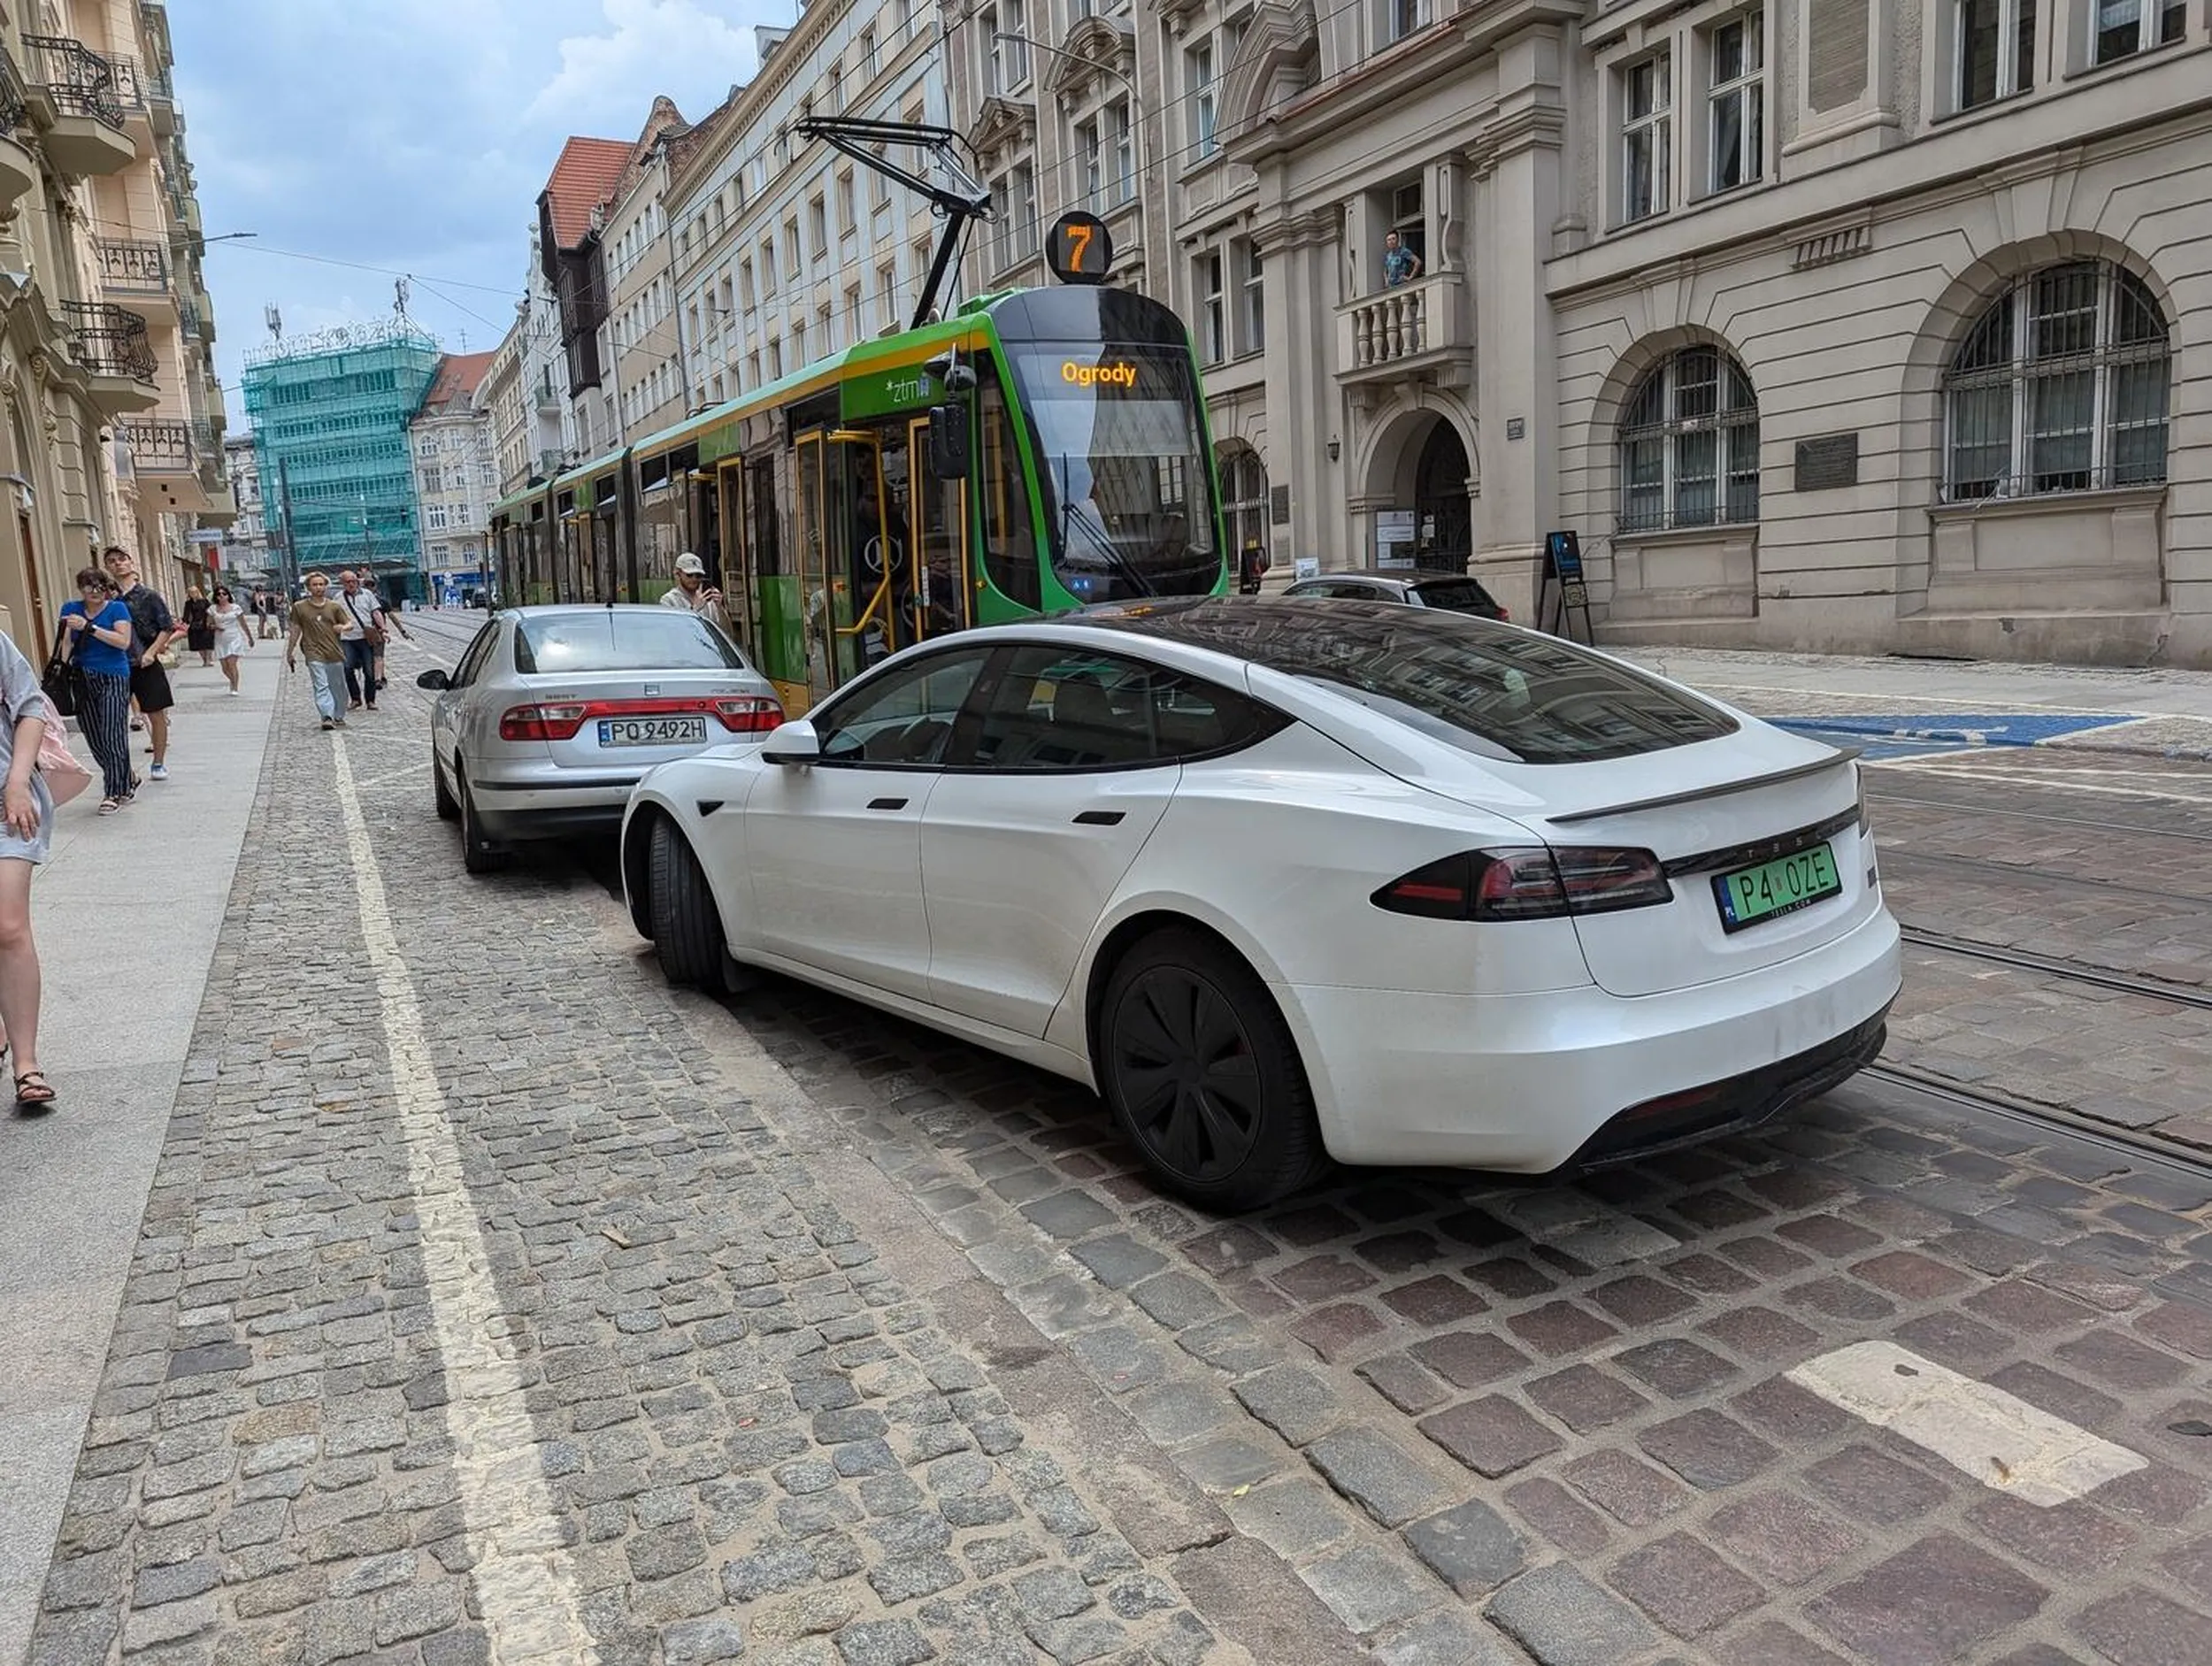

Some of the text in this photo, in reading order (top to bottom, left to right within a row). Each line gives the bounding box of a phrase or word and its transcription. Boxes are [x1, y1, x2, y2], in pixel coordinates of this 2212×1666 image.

[1066, 224, 1093, 273] 7
[1062, 361, 1137, 388] Ogrody
[645, 720, 703, 740] 9492H
[1739, 869, 1776, 915] P4
